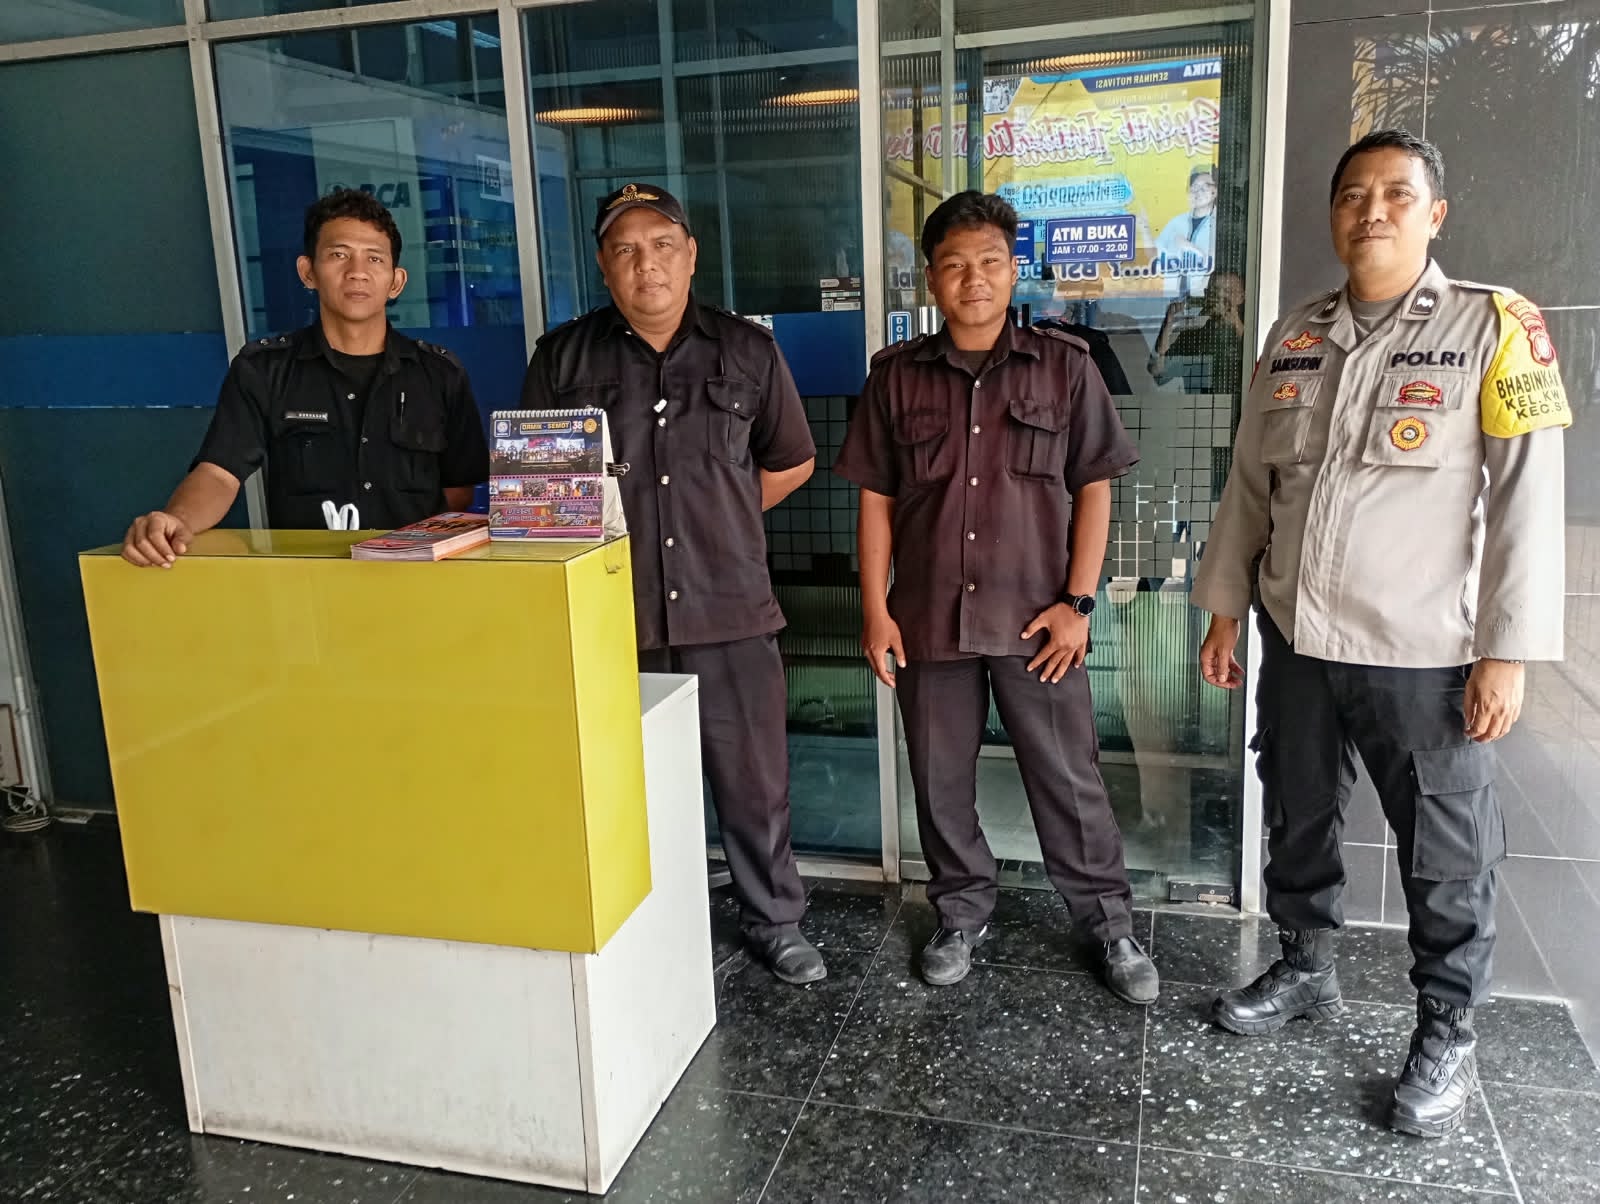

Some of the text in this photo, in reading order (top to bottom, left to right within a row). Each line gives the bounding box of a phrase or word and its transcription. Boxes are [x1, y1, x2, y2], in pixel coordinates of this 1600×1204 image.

[1052, 226, 1083, 241] ATM
[1087, 224, 1128, 239] BUKA
[1052, 247, 1070, 255] JAM
[1077, 245, 1099, 253] 07.00
[1106, 243, 1128, 252] 22.00
[1391, 351, 1466, 368] POLRI
[572, 420, 583, 430] 38
